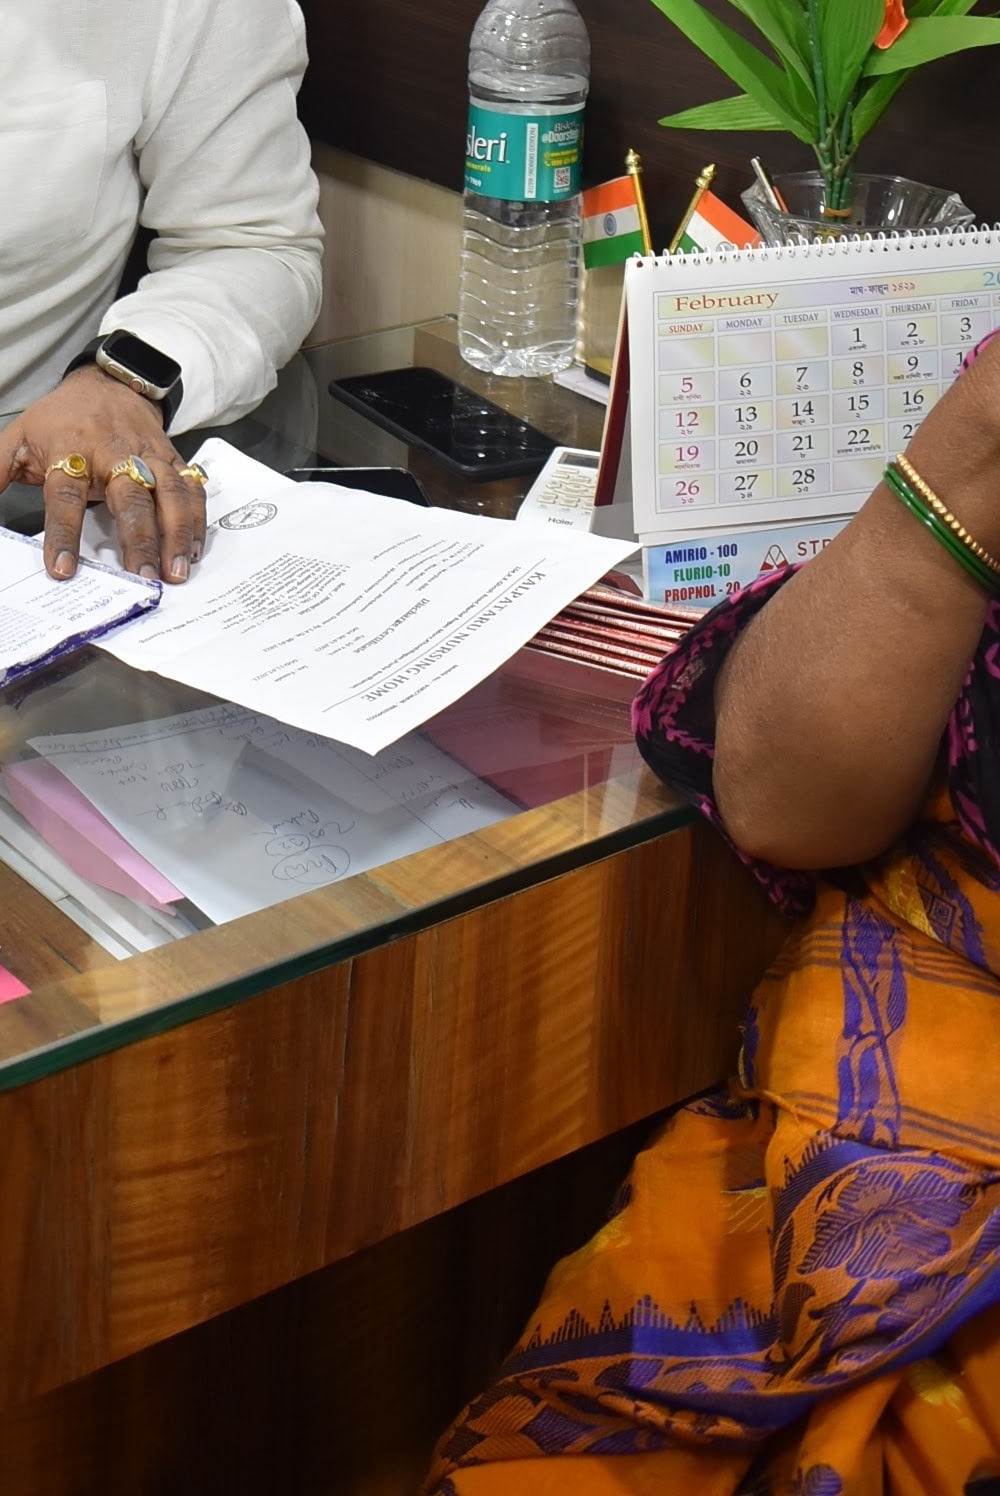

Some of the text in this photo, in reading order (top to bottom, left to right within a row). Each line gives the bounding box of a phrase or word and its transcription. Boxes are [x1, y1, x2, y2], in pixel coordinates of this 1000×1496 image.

[892, 281, 916, 293] ১৪২৯
[669, 298, 979, 334] SUNDAY MONDAY TUESDAY WEDNESDAY THURSDAY FRIDAY
[675, 291, 780, 313] February
[852, 317, 972, 343] 1 2 3
[680, 376, 694, 394] 5
[739, 371, 752, 388] 6
[795, 366, 809, 383] 7
[852, 361, 864, 378] 8
[907, 356, 919, 372] 9
[675, 389, 924, 428] 12 13 14 15 16
[675, 445, 700, 462] 19
[734, 440, 759, 457] 20
[792, 434, 814, 452] 21
[847, 428, 870, 445] 22
[675, 468, 815, 497] 26 27 28
[665, 546, 708, 565] AMIRIO
[716, 543, 738, 558] 100
[673, 563, 731, 582] FLURIO-10
[464, 571, 549, 631] KALPATARU
[664, 583, 716, 604] PROPNOL
[725, 581, 741, 596] 20
[389, 597, 431, 628] Discharge
[351, 625, 397, 654] Certificate
[403, 631, 471, 676] NURSING
[359, 674, 410, 703] HOME
